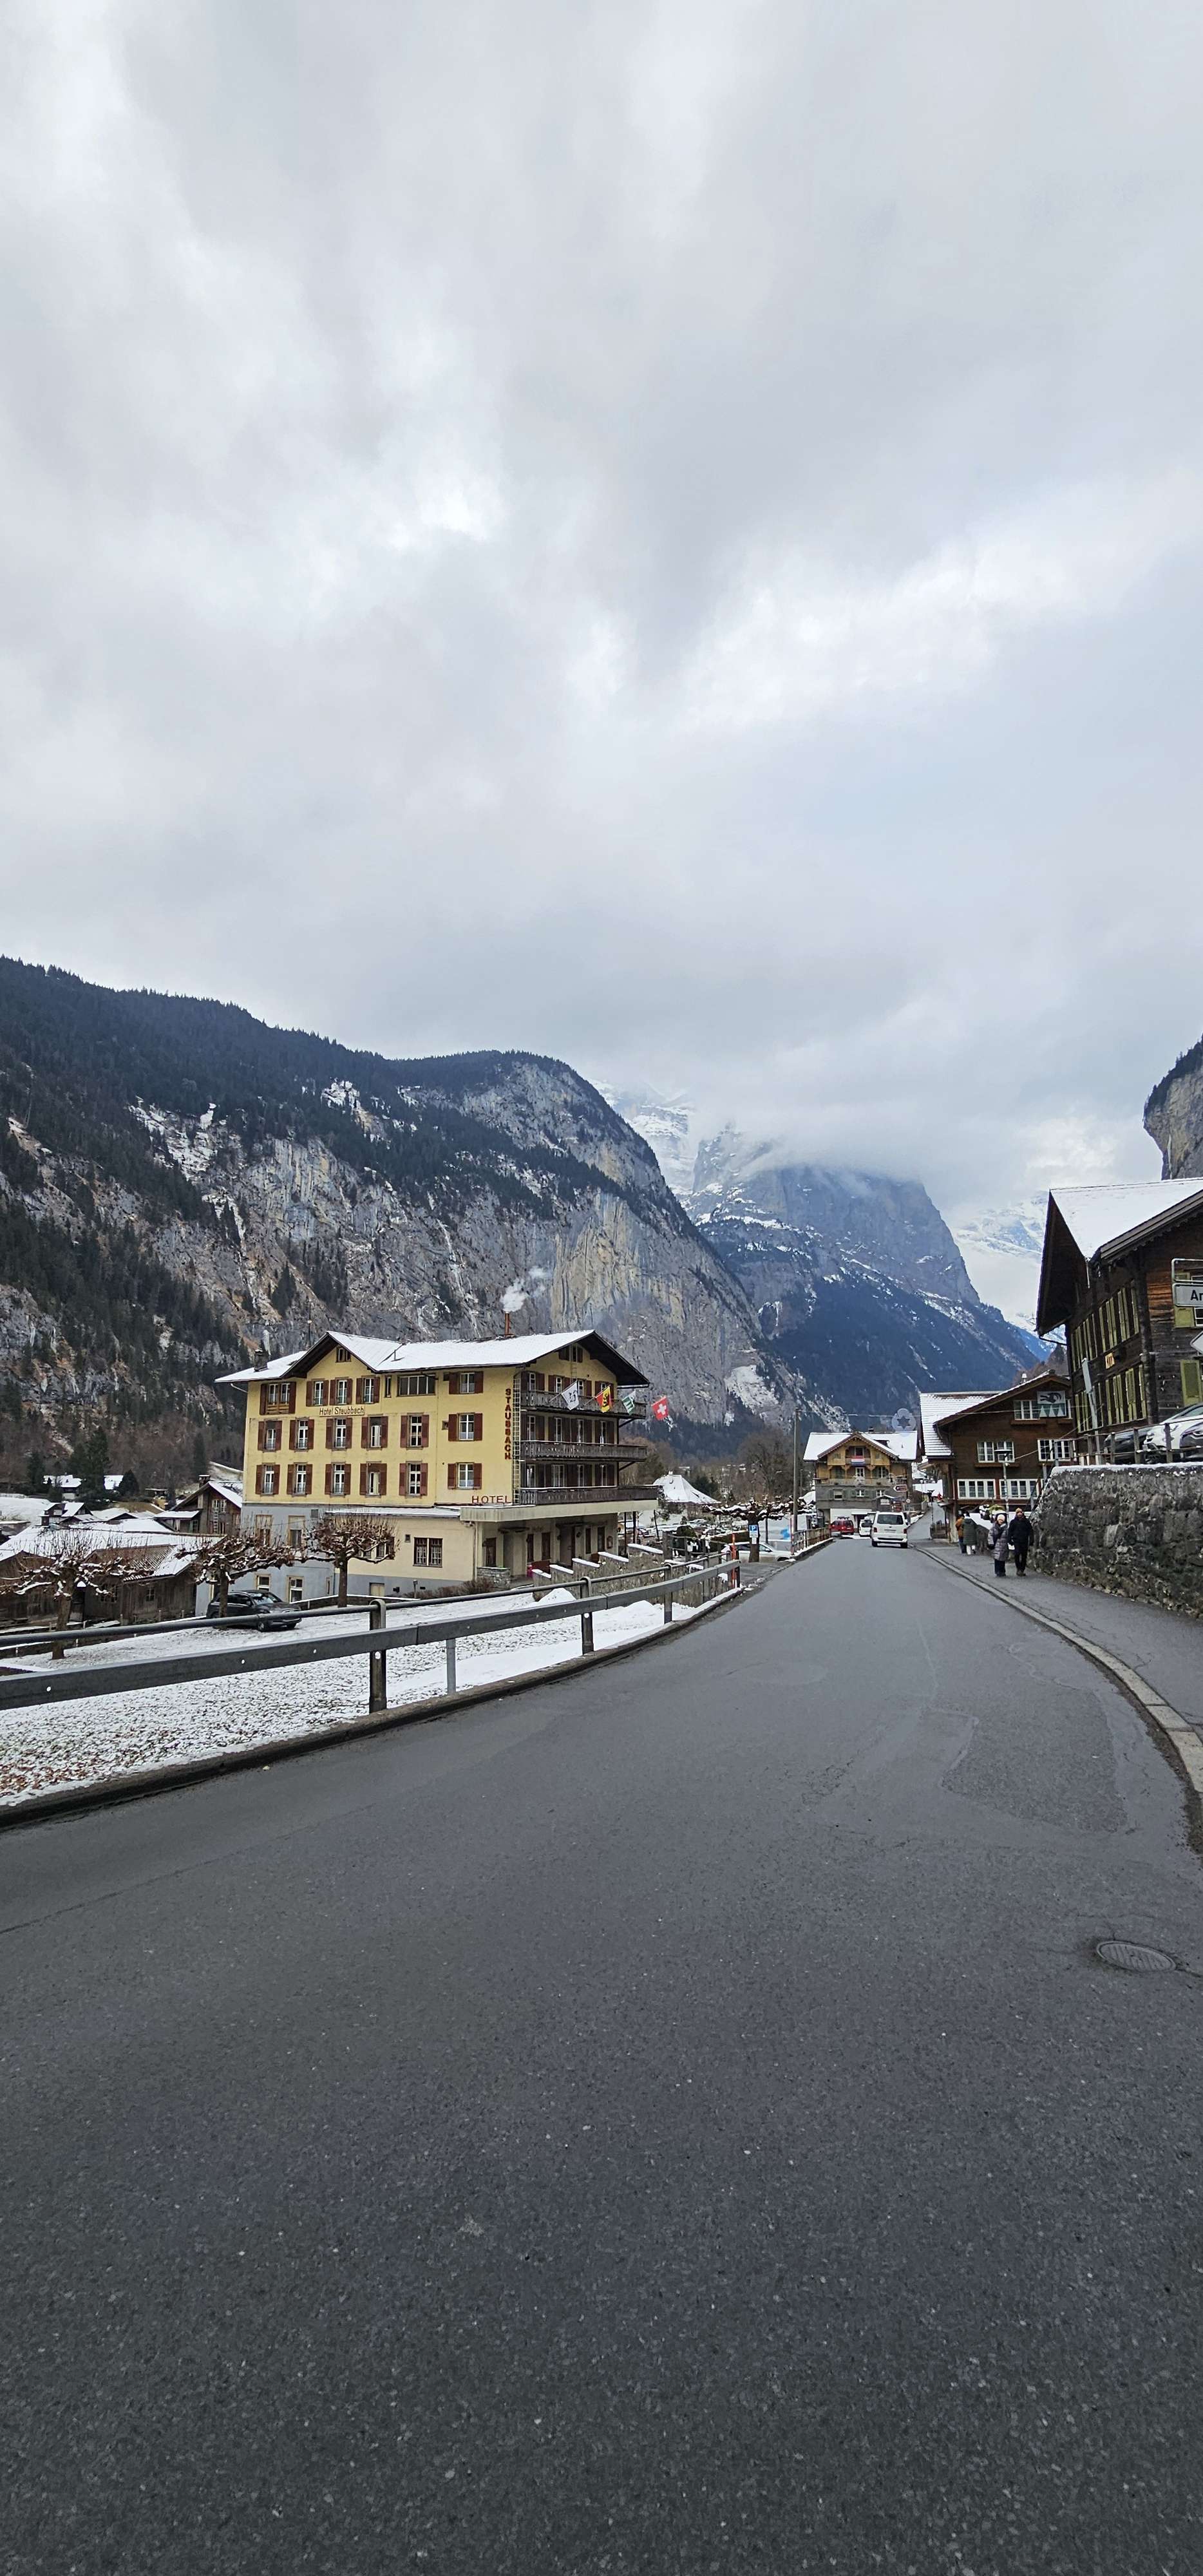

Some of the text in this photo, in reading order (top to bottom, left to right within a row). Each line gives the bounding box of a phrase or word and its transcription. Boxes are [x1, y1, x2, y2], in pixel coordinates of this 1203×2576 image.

[319, 1406, 364, 1416] Hotel Staubbach
[471, 1495, 512, 1504] HOTEL
